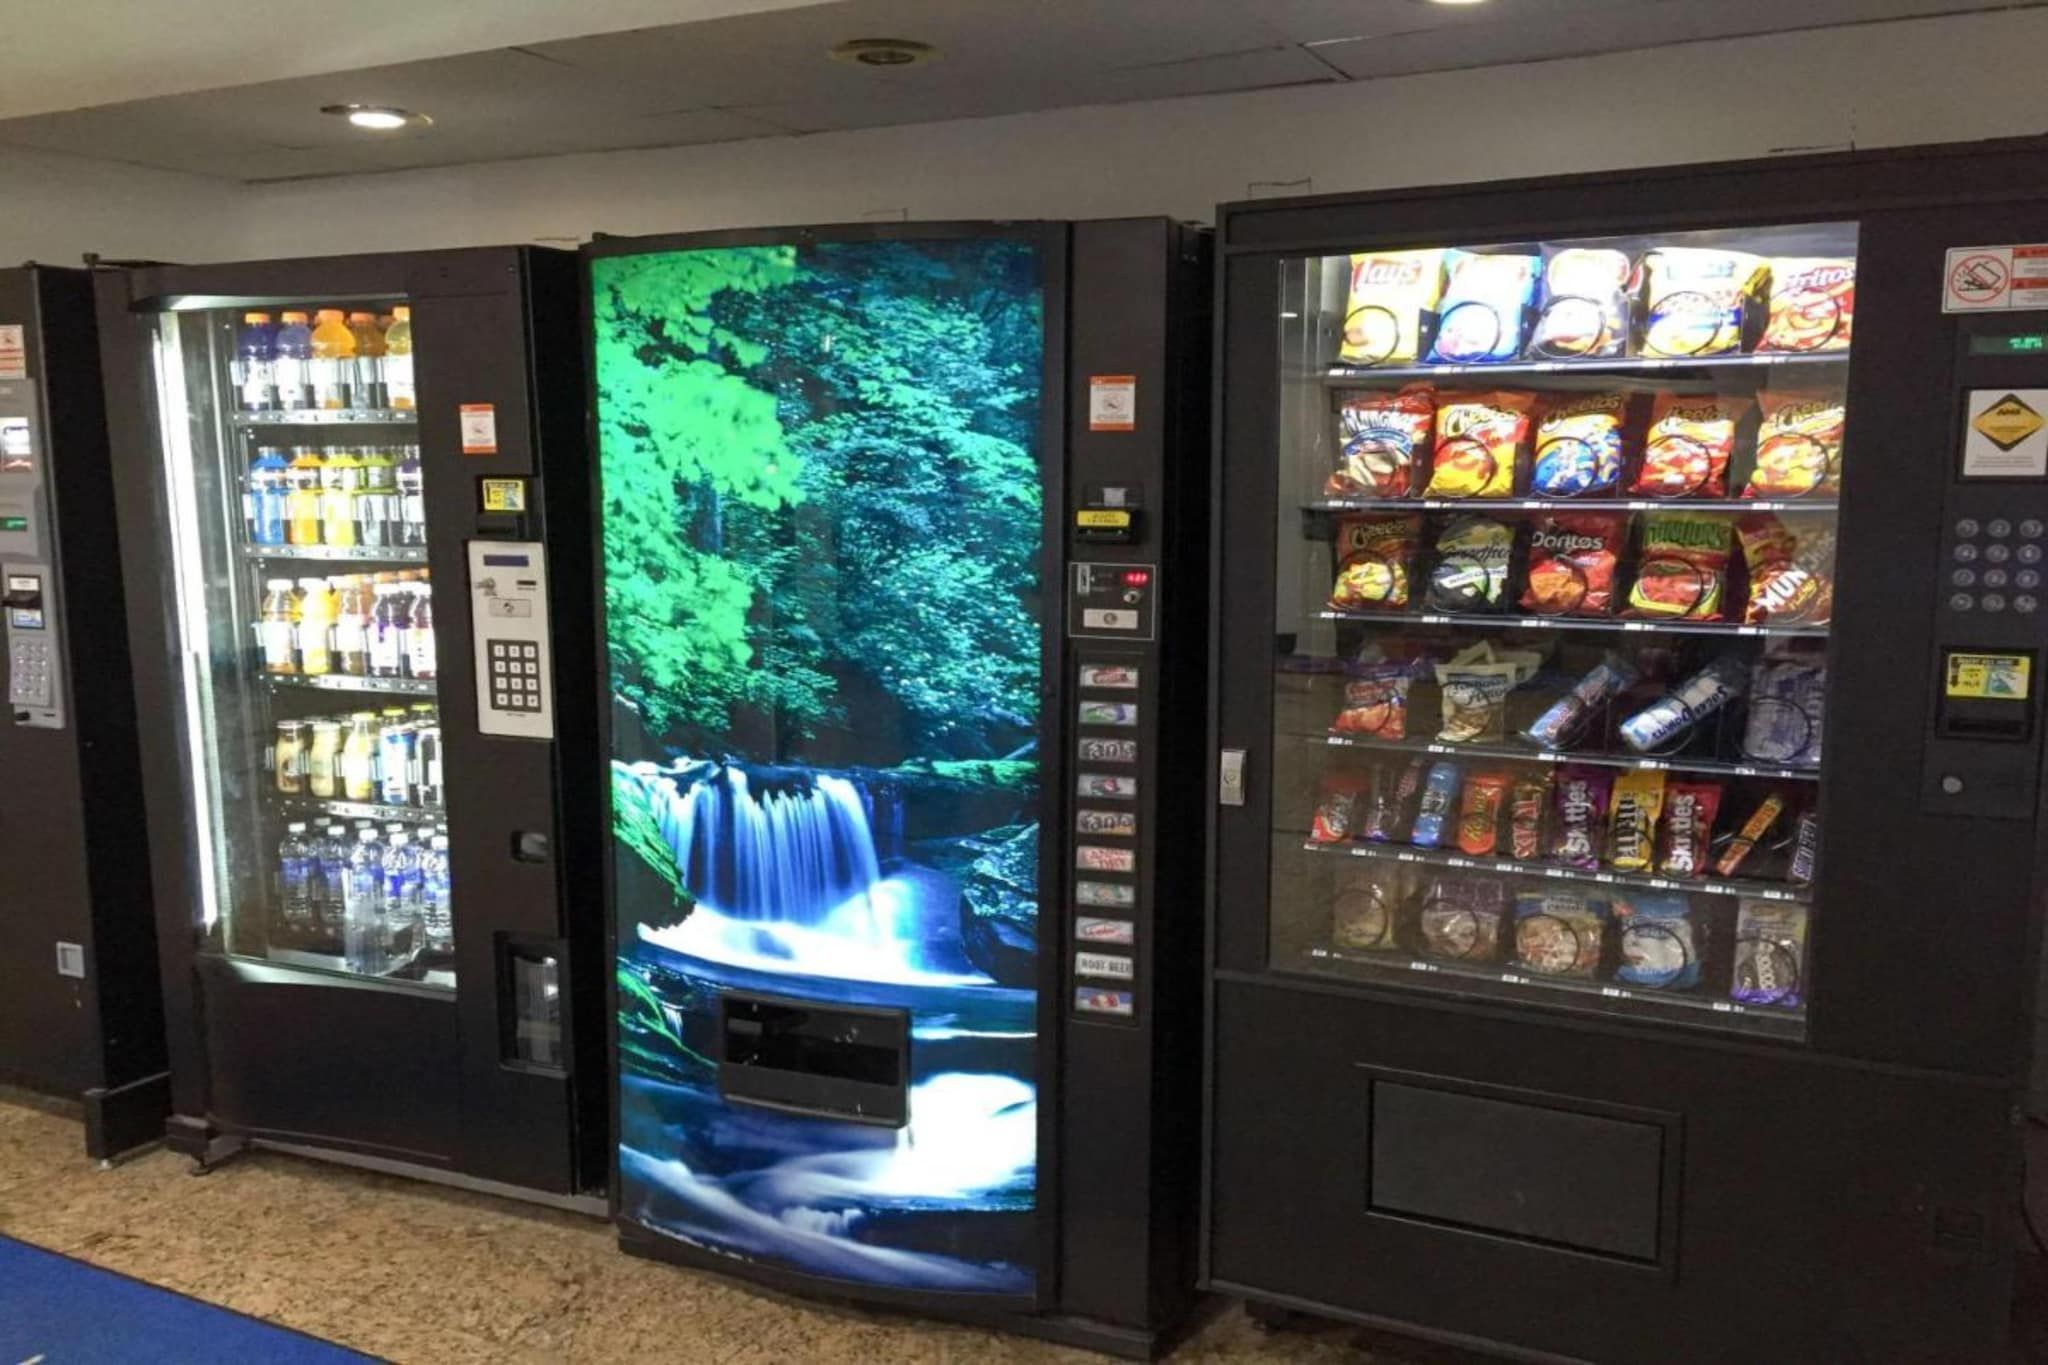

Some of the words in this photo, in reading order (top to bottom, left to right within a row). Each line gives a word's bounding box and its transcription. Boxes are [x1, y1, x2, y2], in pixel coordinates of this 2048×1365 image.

[1532, 529, 1604, 549] Doritos
[1566, 780, 1591, 854] Skittles
[1671, 794, 1697, 872] Skittles
[1081, 957, 1105, 971] ROOT
